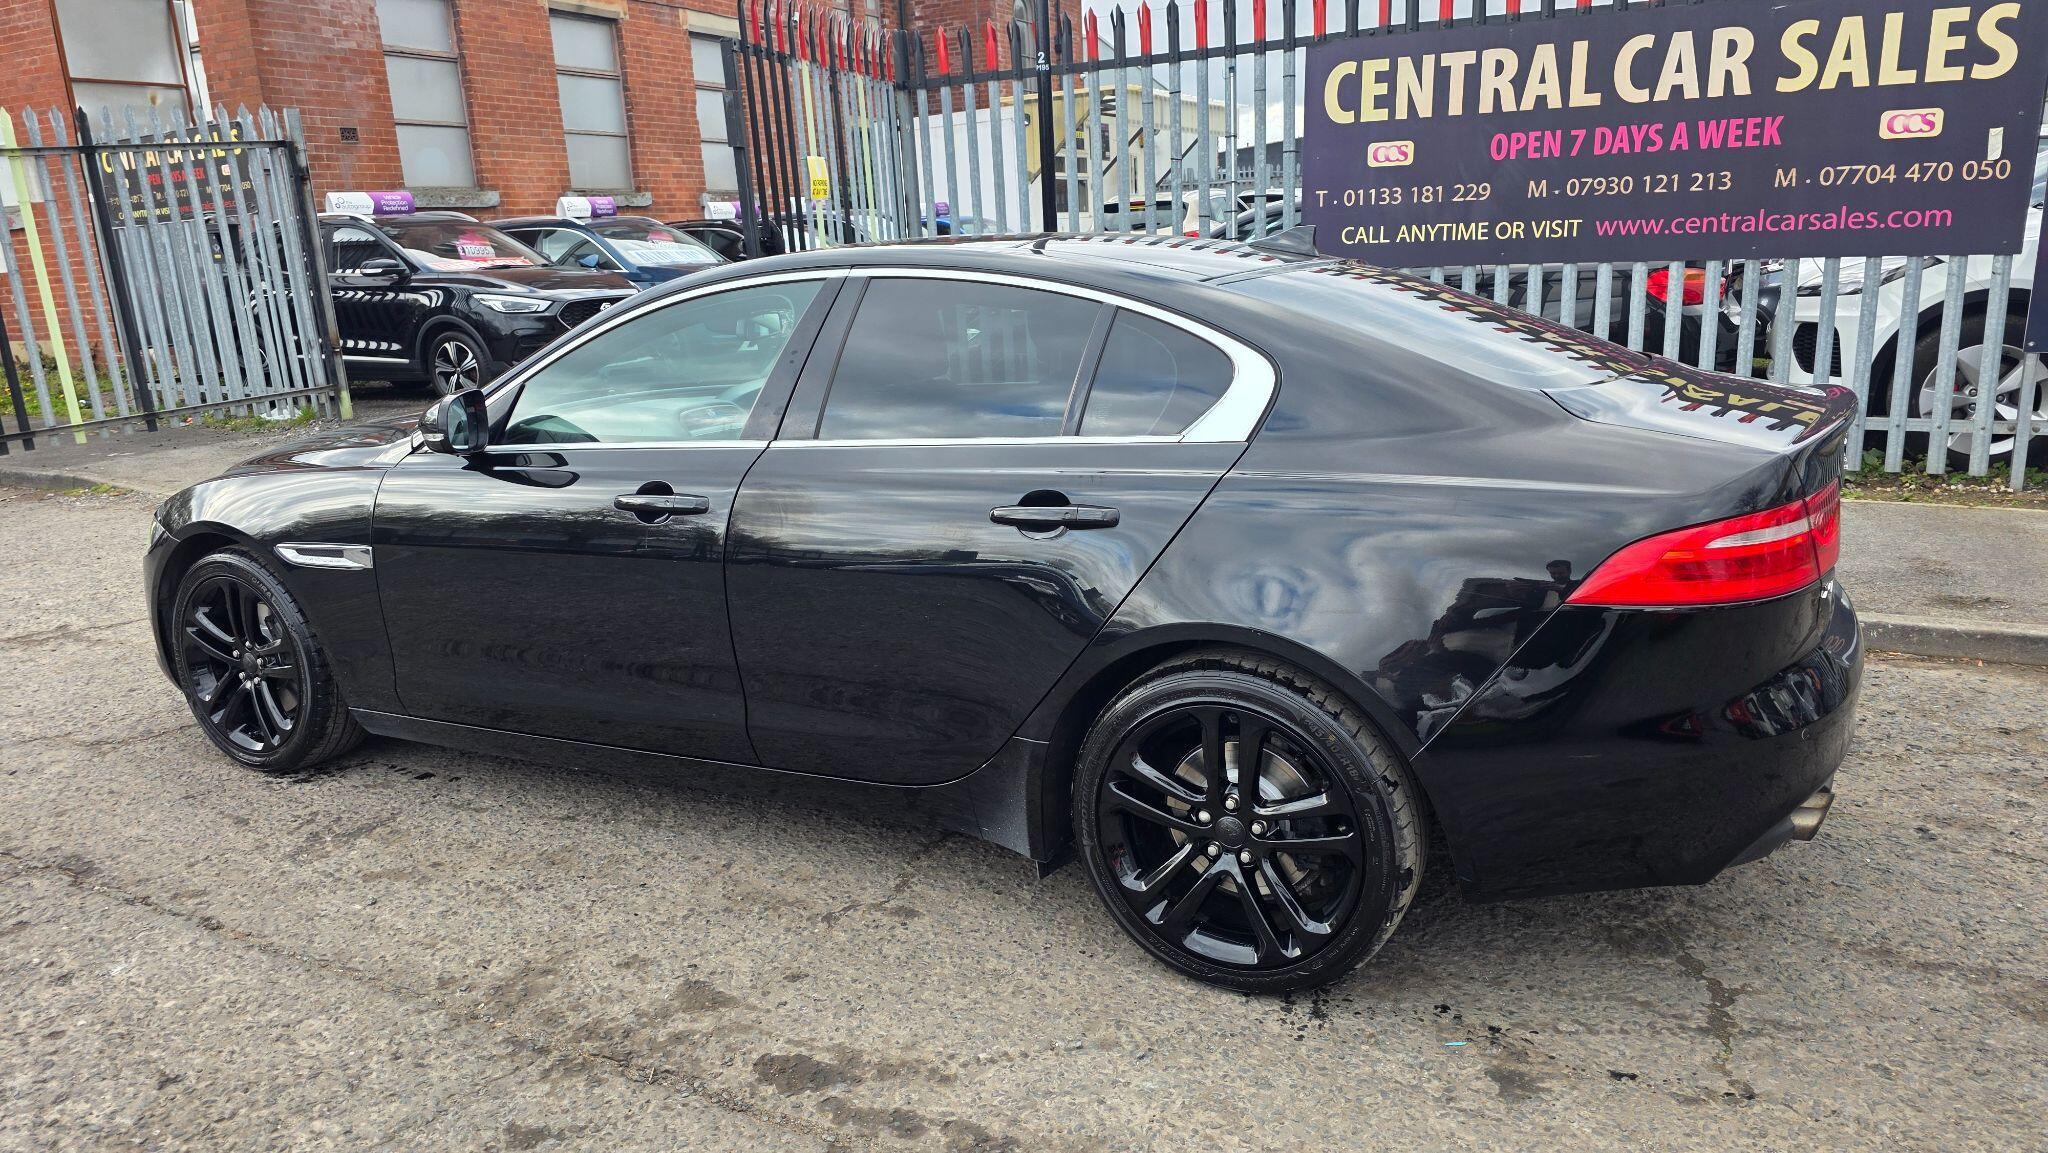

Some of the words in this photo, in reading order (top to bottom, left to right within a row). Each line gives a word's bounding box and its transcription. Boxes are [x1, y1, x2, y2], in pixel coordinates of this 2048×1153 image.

[1037, 51, 1045, 64] 2
[1324, 40, 1601, 124] CENTRAL
[1614, 27, 1754, 103] CAR
[1776, 2, 2021, 92] SALES
[1490, 130, 1561, 161] OPEN
[1569, 129, 1586, 156] 7
[1594, 123, 1664, 155] DAYS
[1670, 122, 1689, 150] A
[1698, 116, 1784, 149] WEEK
[1567, 176, 1634, 197] 07930
[1644, 174, 1679, 193] 121
[1690, 171, 1732, 191] 213
[1819, 164, 1897, 186] 07704
[1904, 162, 1954, 182] 470
[1963, 159, 2011, 181] 050
[1344, 186, 1402, 207] 01133
[1412, 185, 1443, 204] 181
[1452, 183, 1491, 201] 229
[1341, 225, 1391, 245] CALL
[1396, 222, 1490, 243] ANYTIME
[1495, 221, 1525, 240] OR
[1531, 219, 1583, 239] VISIT
[1595, 205, 1953, 236] www.centralcarsales.com
